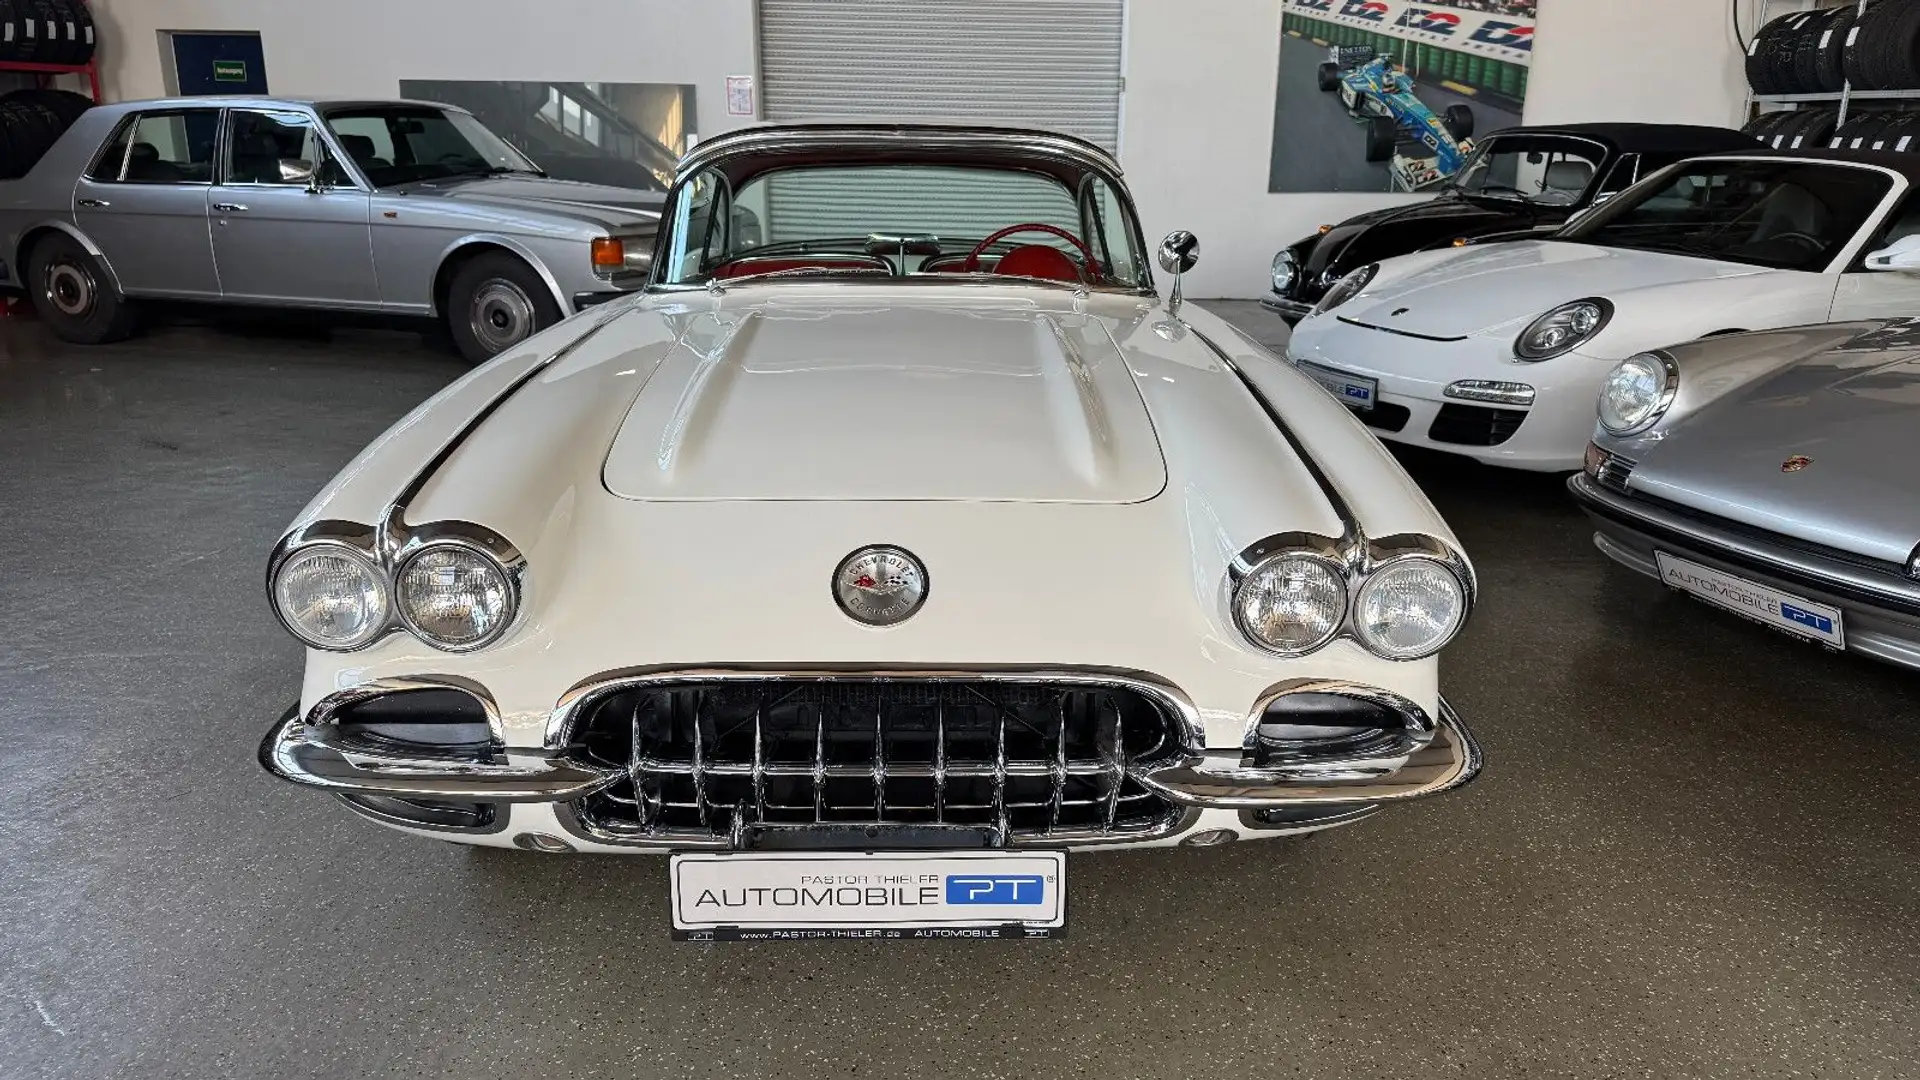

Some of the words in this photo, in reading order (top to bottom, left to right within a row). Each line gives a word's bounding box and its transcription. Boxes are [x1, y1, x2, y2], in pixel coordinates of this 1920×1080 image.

[849, 555, 914, 576] CHEVROLET
[1669, 569, 1780, 616] AUTOMOBILE
[1783, 604, 1829, 628] PT
[801, 875, 868, 885] PASTOR
[873, 874, 939, 885] THIELER
[695, 886, 939, 907] AUTOMOBILE
[952, 879, 1036, 901] PT
[914, 929, 1000, 938] AUTOMOBILE
